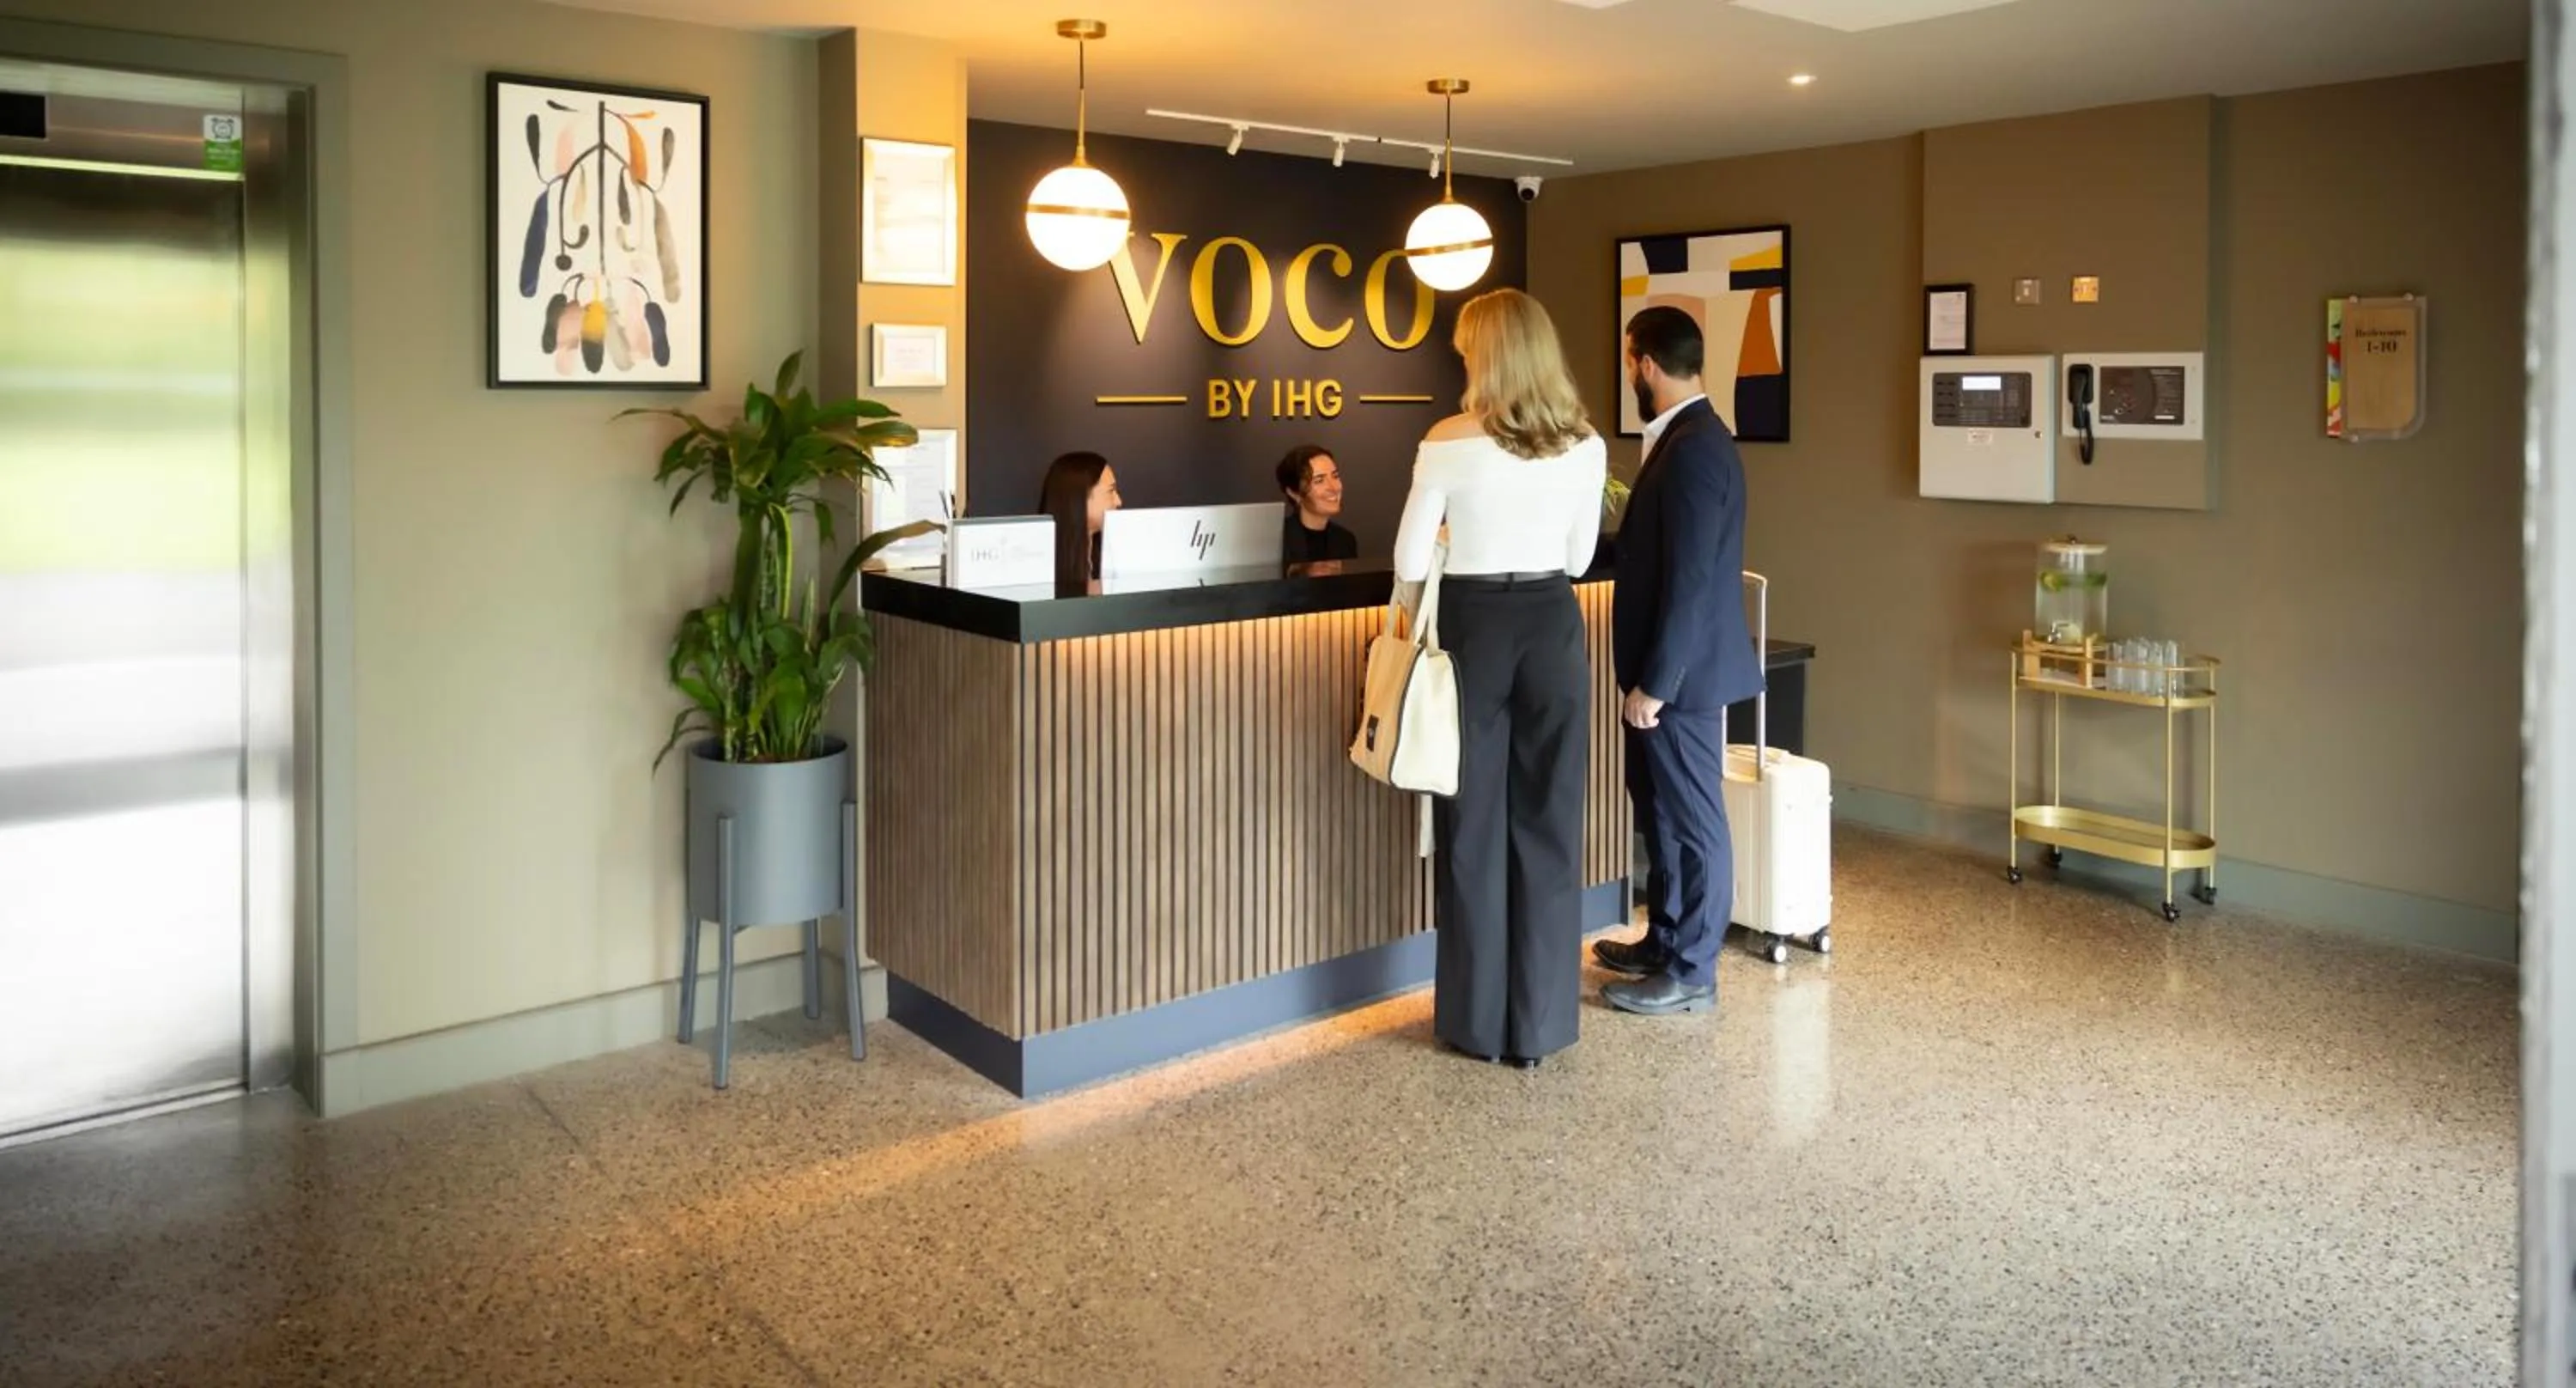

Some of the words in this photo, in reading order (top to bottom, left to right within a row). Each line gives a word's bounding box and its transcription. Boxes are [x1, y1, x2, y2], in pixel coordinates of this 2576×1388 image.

[1208, 379, 1257, 418] BY
[1273, 379, 1343, 418] IHG
[1190, 520, 1216, 561] hp
